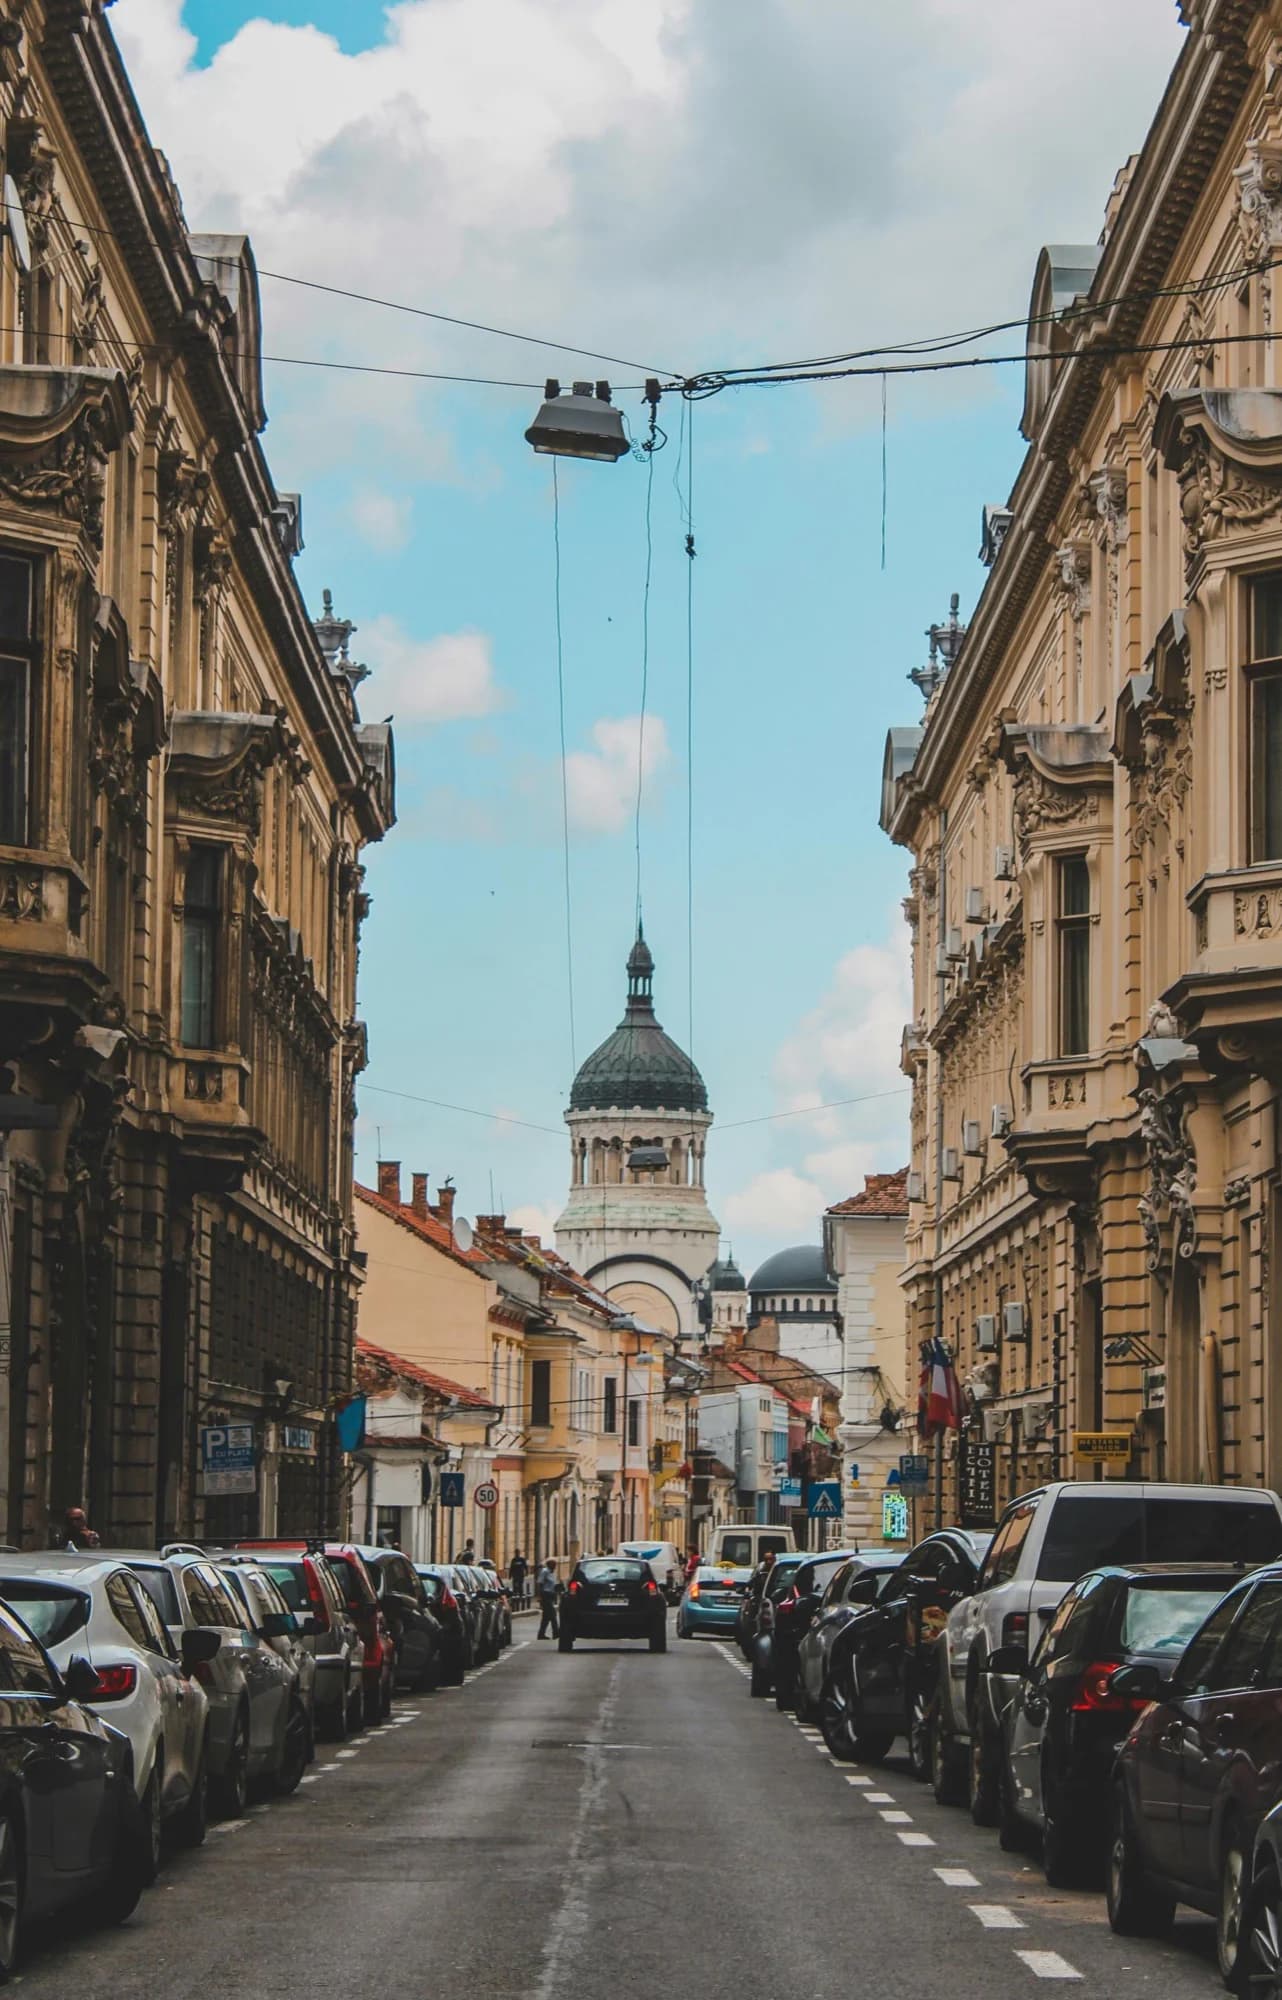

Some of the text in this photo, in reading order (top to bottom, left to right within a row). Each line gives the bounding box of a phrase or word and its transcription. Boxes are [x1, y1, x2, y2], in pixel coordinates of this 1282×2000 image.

[207, 1430, 225, 1457] P
[977, 1447, 992, 1501] HOTEL
[782, 1478, 791, 1491] P
[480, 1490, 494, 1502] 50
